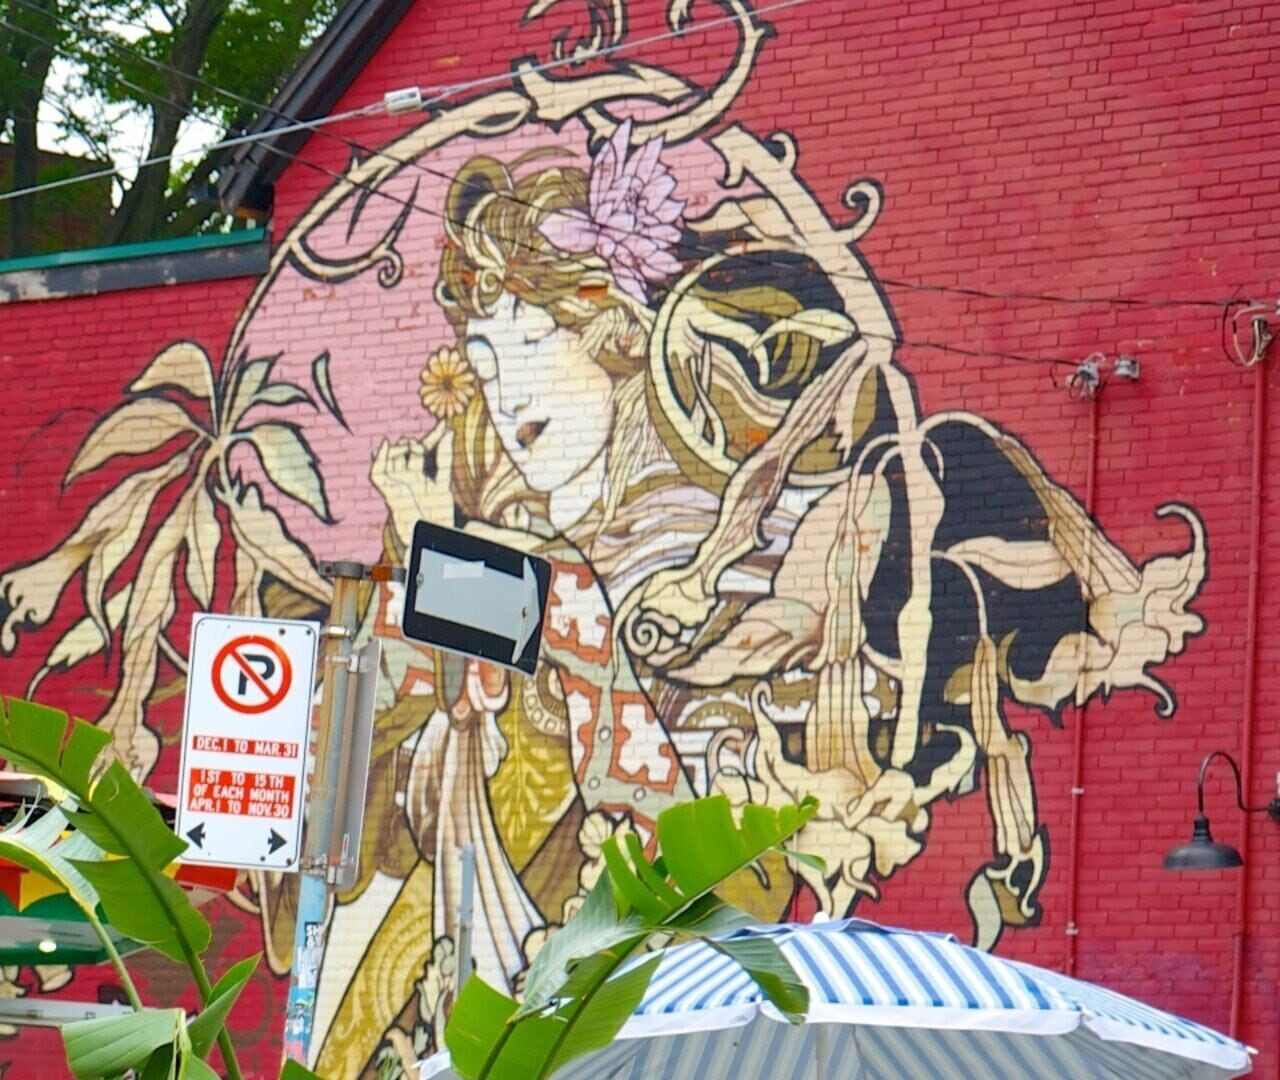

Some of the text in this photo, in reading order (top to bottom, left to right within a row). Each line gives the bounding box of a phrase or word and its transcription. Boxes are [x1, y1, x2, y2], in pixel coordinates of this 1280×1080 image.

[234, 740, 248, 754] TO
[200, 770, 221, 784] 1ST
[231, 772, 246, 786] TO
[193, 784, 290, 802] OF EACH MONTH
[227, 801, 242, 815] TO
